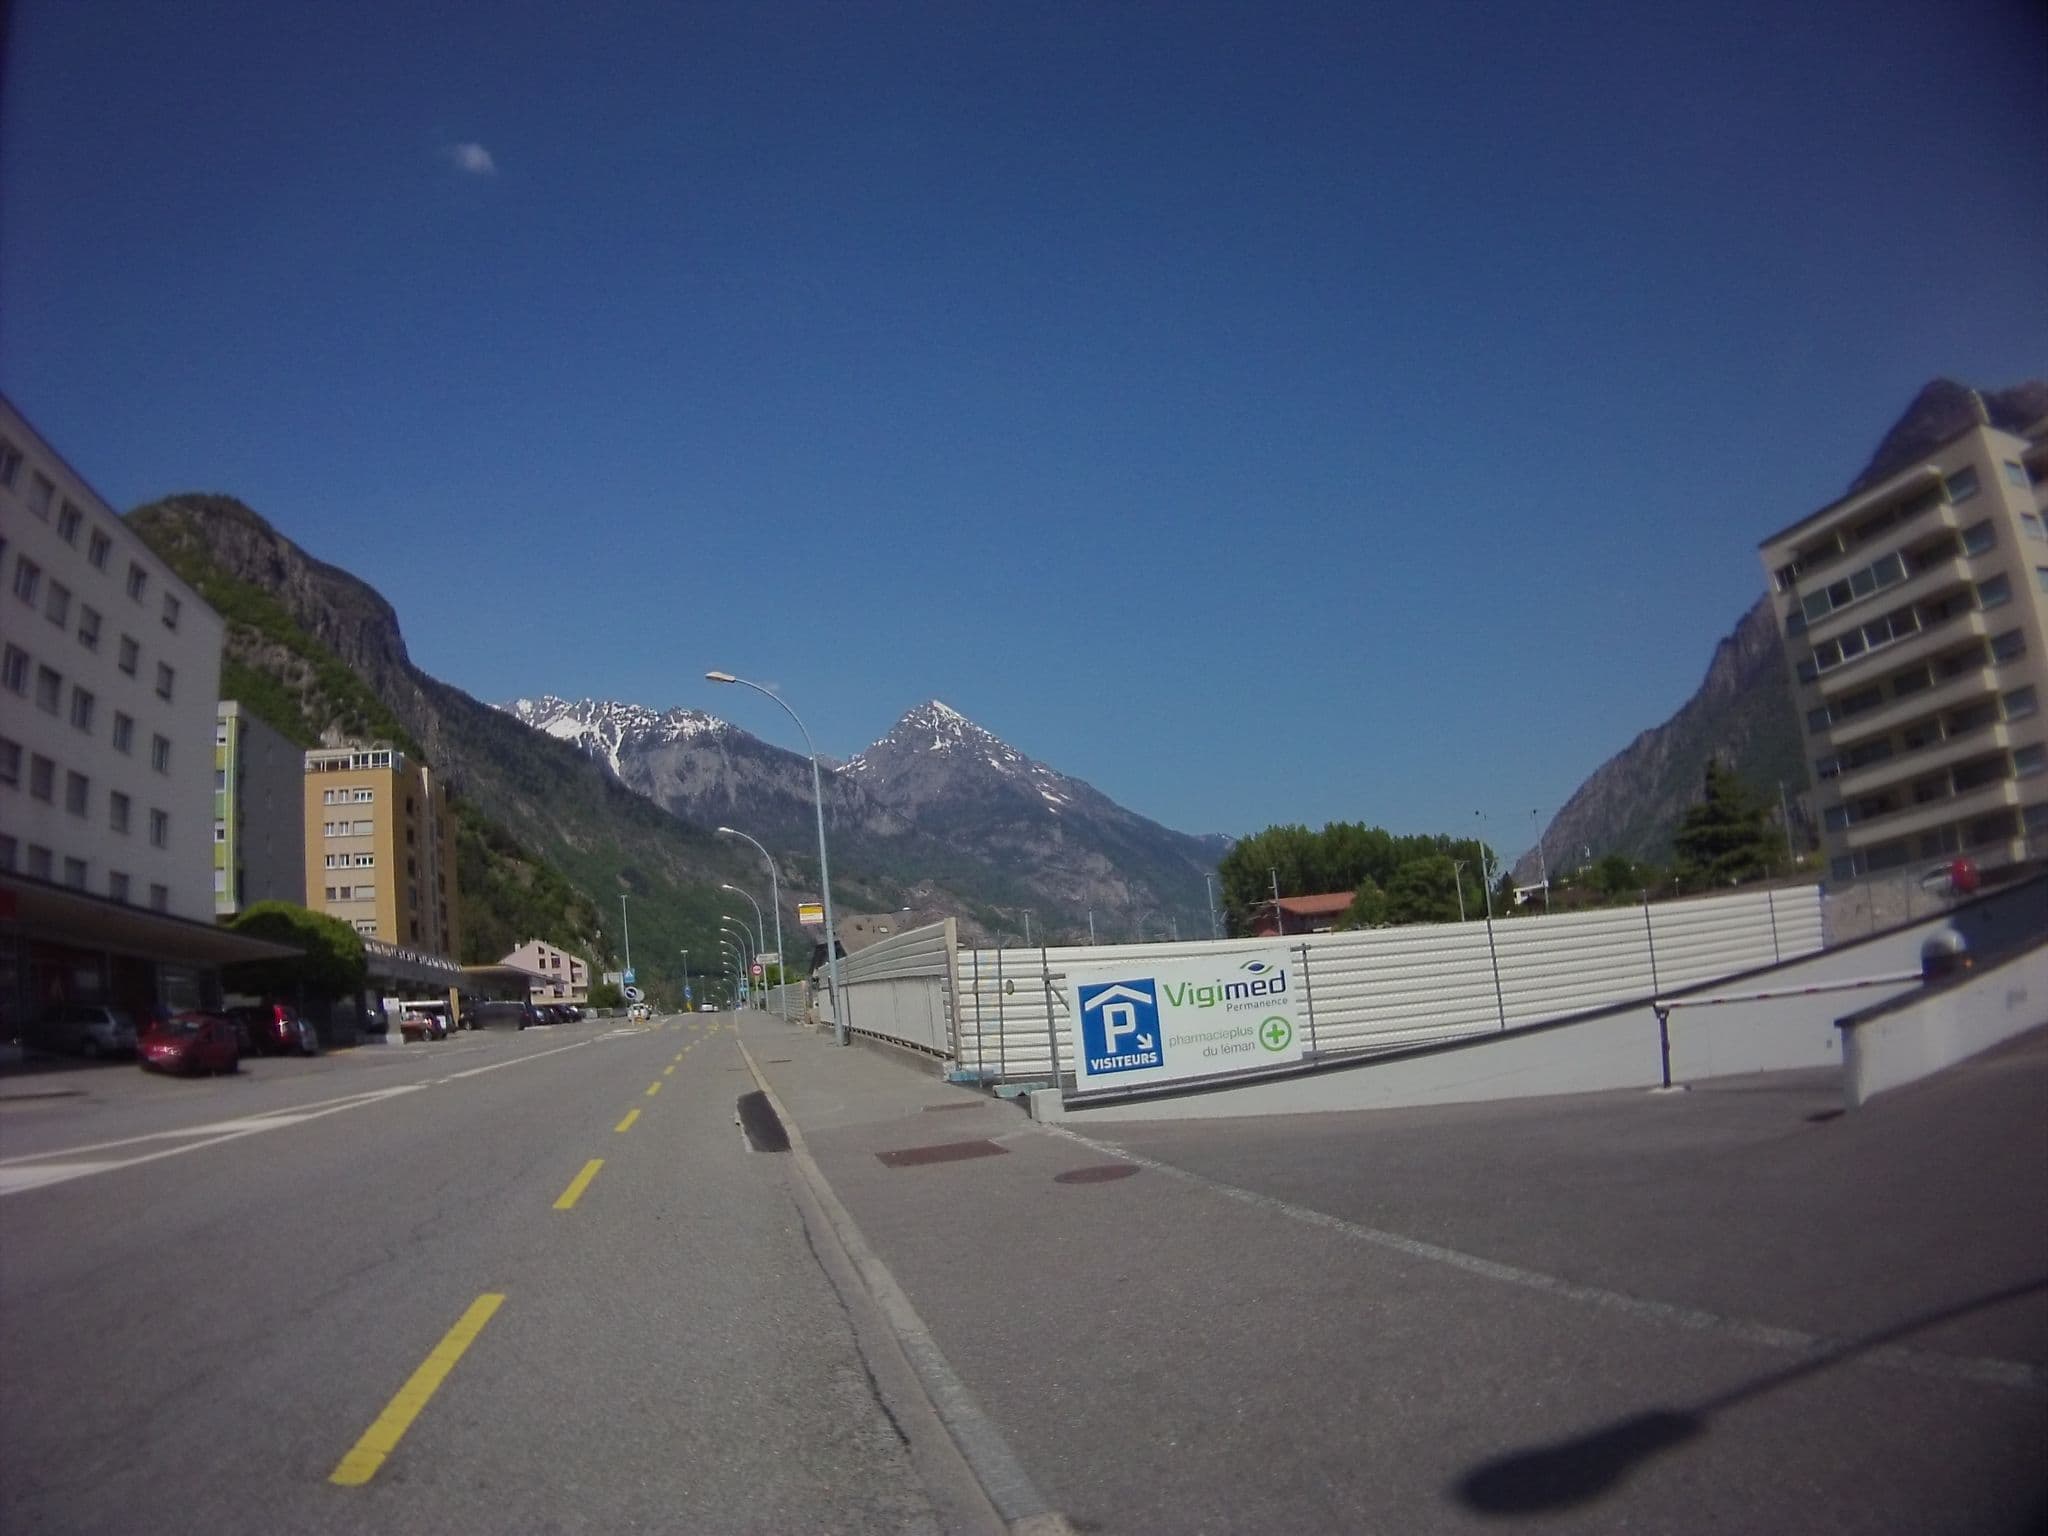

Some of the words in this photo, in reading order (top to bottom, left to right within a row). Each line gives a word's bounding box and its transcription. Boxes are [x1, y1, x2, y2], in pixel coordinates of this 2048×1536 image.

[1163, 970, 1286, 1008] Vigimed
[1226, 997, 1288, 1012] Permanence
[1103, 1002, 1136, 1053] P
[1169, 1025, 1253, 1048] pharmacieplus
[1203, 1045, 1217, 1057] du
[1221, 1042, 1255, 1055] léman
[1091, 1052, 1157, 1072] VISITEURS
